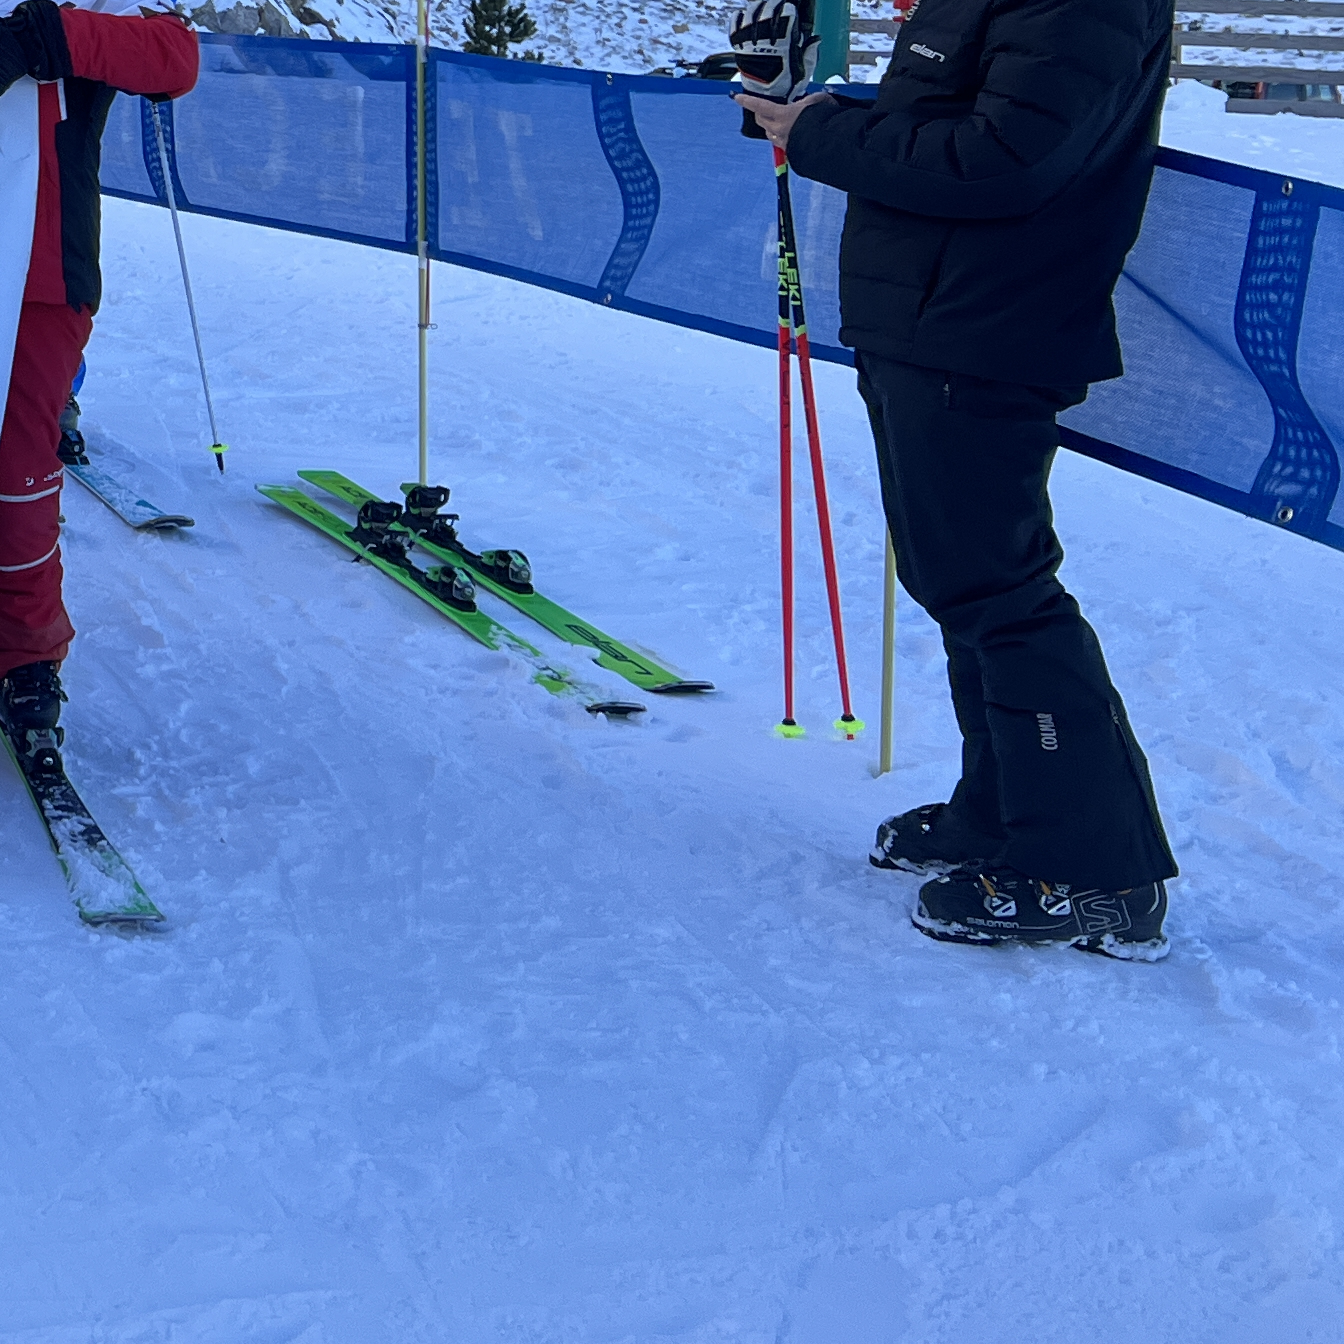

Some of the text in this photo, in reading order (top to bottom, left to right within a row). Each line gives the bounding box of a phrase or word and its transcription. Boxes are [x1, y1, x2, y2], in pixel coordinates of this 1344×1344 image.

[909, 43, 946, 63] elan
[785, 251, 801, 306] LEKI
[1036, 712, 1059, 751] COLMAR
